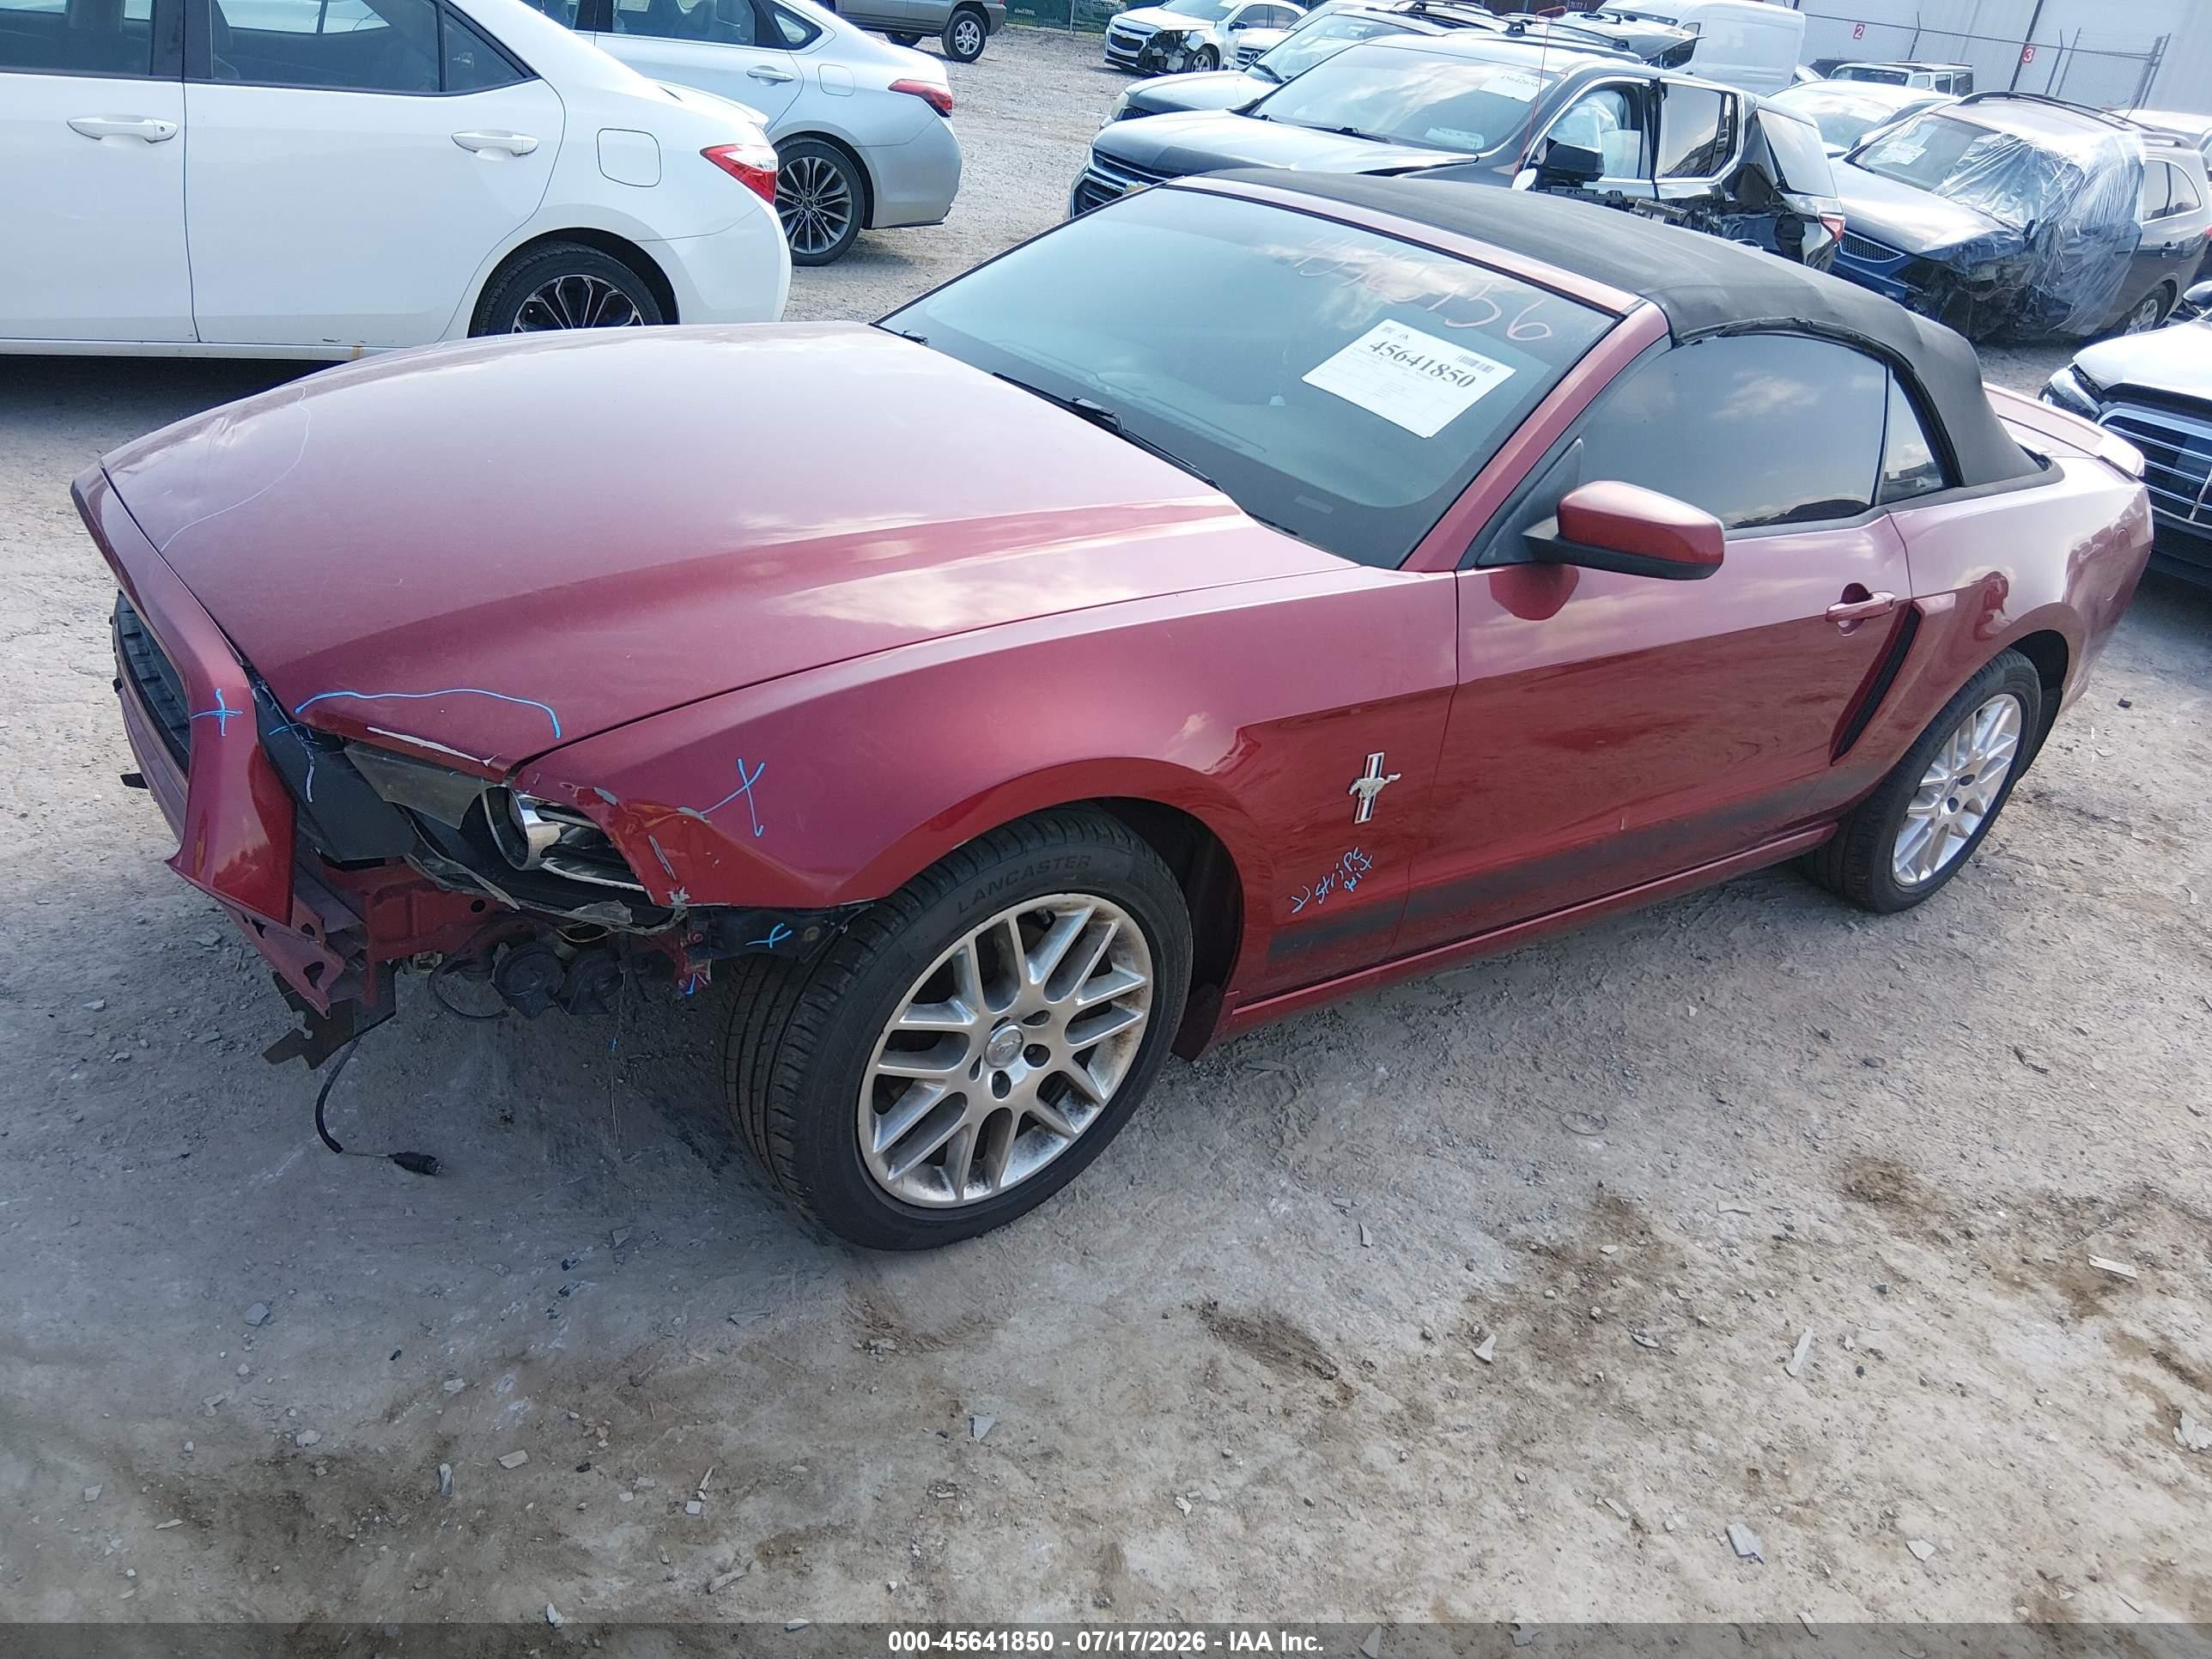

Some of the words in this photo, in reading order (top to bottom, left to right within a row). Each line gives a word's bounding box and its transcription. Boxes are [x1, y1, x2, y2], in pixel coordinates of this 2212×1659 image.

[1854, 25, 1863, 39] 2
[2023, 48, 2034, 63] 3
[1369, 340, 1477, 388] 45641850
[957, 854, 1092, 915] LANCASTER
